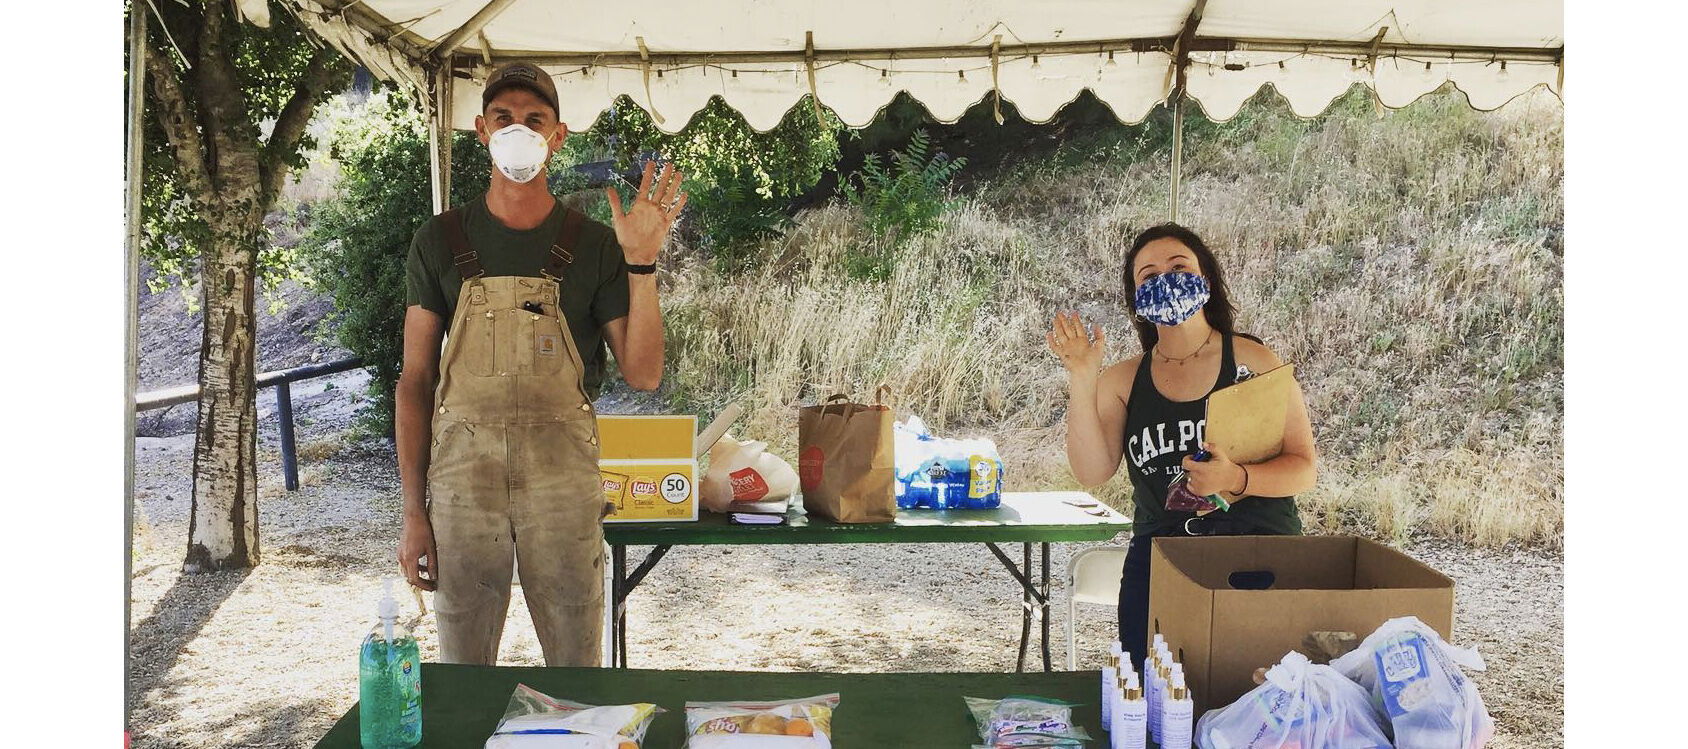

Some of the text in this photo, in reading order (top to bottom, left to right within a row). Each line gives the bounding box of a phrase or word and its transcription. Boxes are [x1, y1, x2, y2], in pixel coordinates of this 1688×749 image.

[1128, 422, 1174, 467] CAL
[1165, 465, 1185, 474] LU
[667, 479, 685, 491] 50
